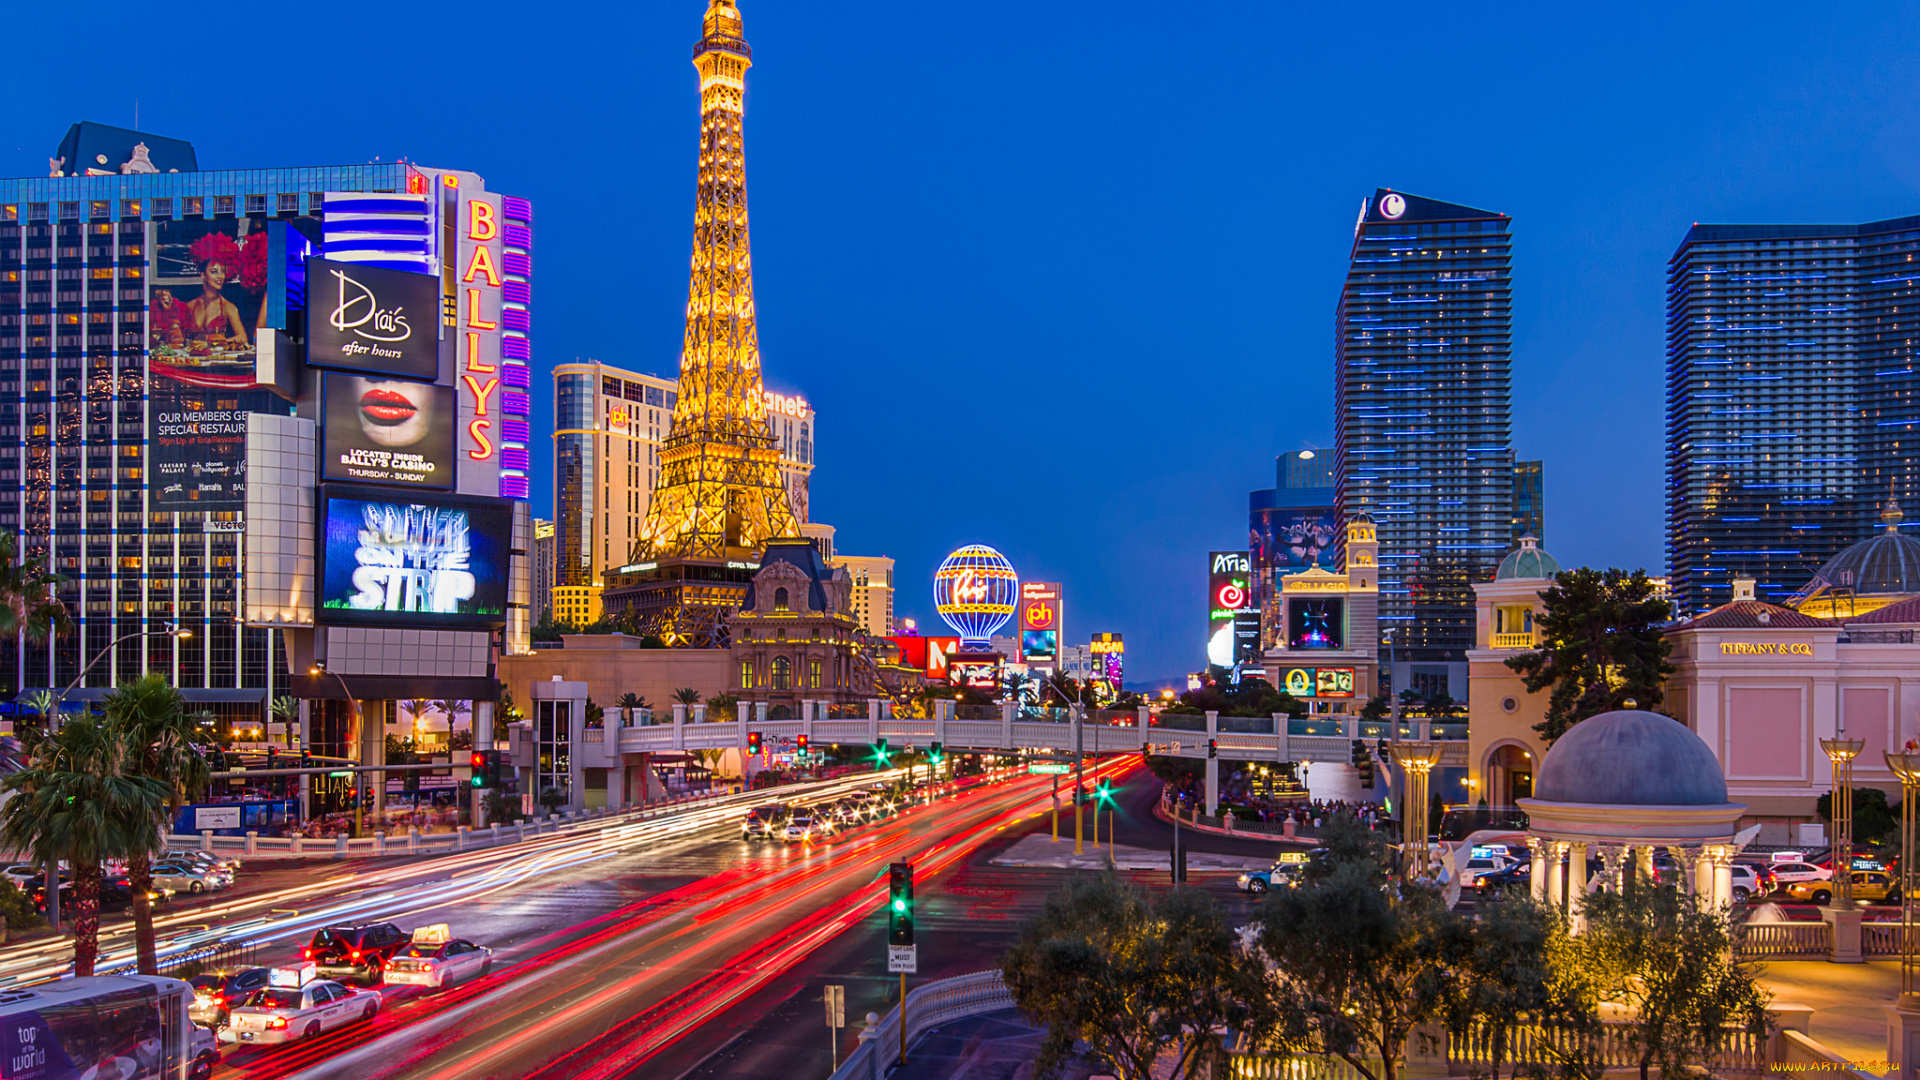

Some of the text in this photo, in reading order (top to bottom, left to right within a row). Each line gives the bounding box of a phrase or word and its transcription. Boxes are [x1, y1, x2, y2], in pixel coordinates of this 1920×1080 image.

[329, 269, 412, 342] Drai's
[463, 199, 500, 461] BALLYS
[342, 341, 402, 358] after hours
[158, 412, 181, 423] OUR
[183, 411, 231, 422] MEMBERS
[158, 423, 246, 435] SPECIAL RESTAUR
[158, 436, 174, 446] Sign
[175, 436, 186, 446] Up
[187, 436, 195, 444] at
[350, 448, 424, 462] LOCATED INSIDE
[341, 454, 435, 472] BALLY'S CASINO
[348, 468, 389, 479] THURSDAY
[395, 472, 425, 482] SUNDAY
[1213, 554, 1249, 574] Aria
[349, 566, 476, 613] STRIP
[1291, 581, 1346, 591] BELLAGIO
[1090, 641, 1124, 653] MGM
[1720, 642, 1777, 655] TIFFANY
[1778, 643, 1788, 655] &
[18, 1026, 36, 1044] top
[13, 1047, 45, 1073] world
